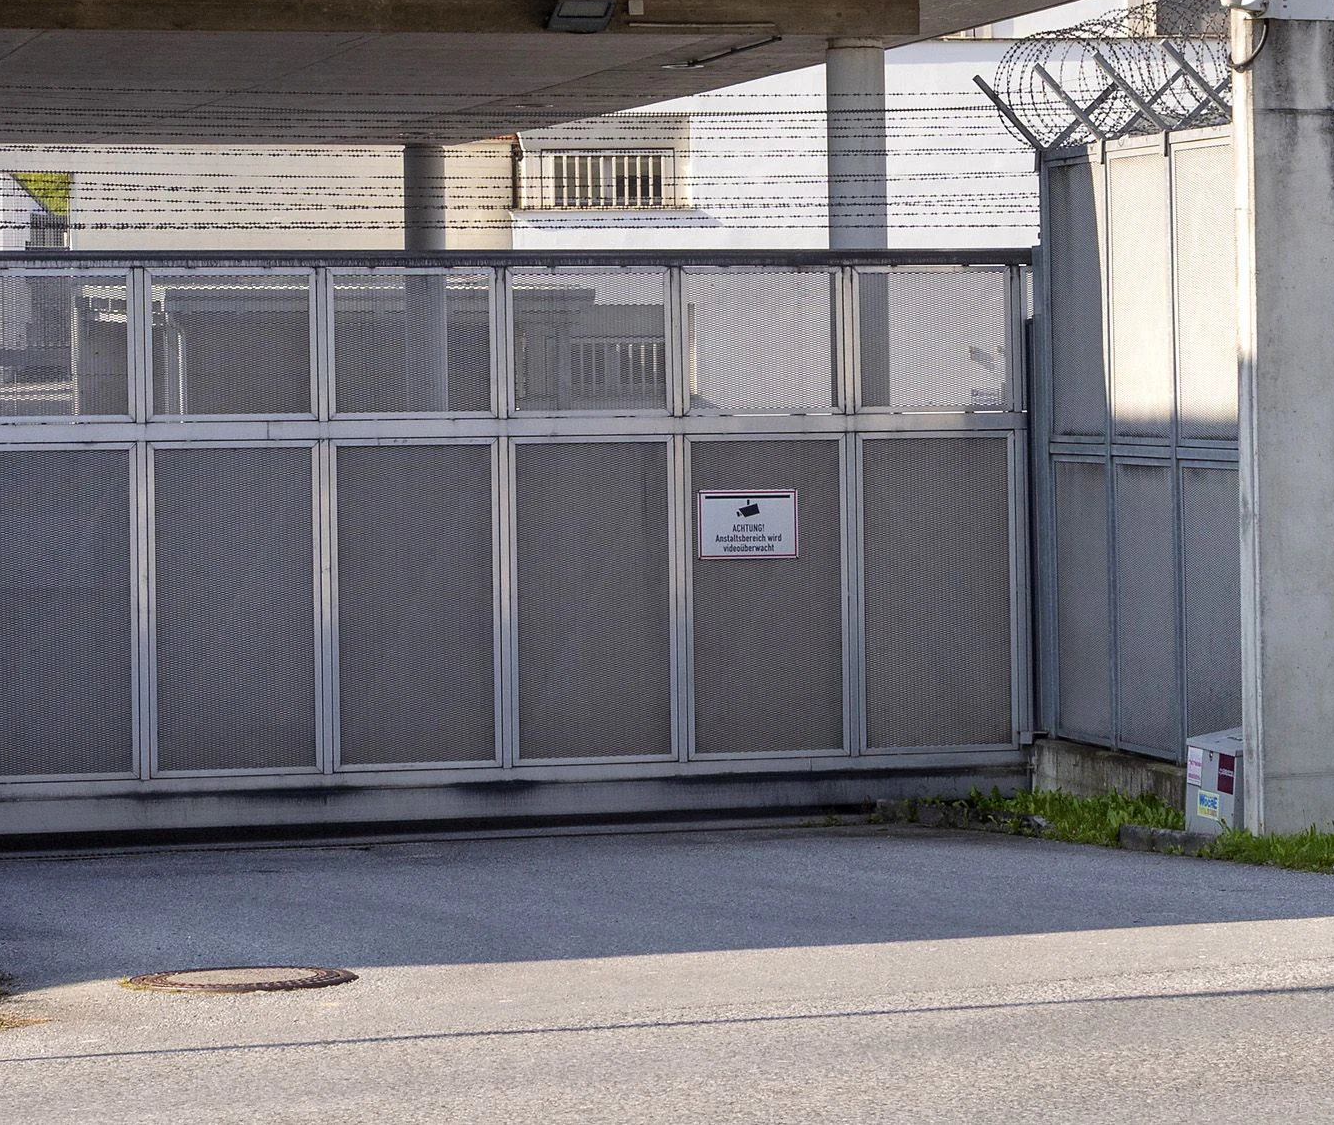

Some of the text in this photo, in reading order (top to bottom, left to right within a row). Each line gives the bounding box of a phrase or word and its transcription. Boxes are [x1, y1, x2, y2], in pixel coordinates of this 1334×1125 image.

[733, 524, 764, 532] ACHTUNG!
[716, 534, 781, 542] Anstaltsbereich wird
[723, 544, 774, 552] videoüberwacht
